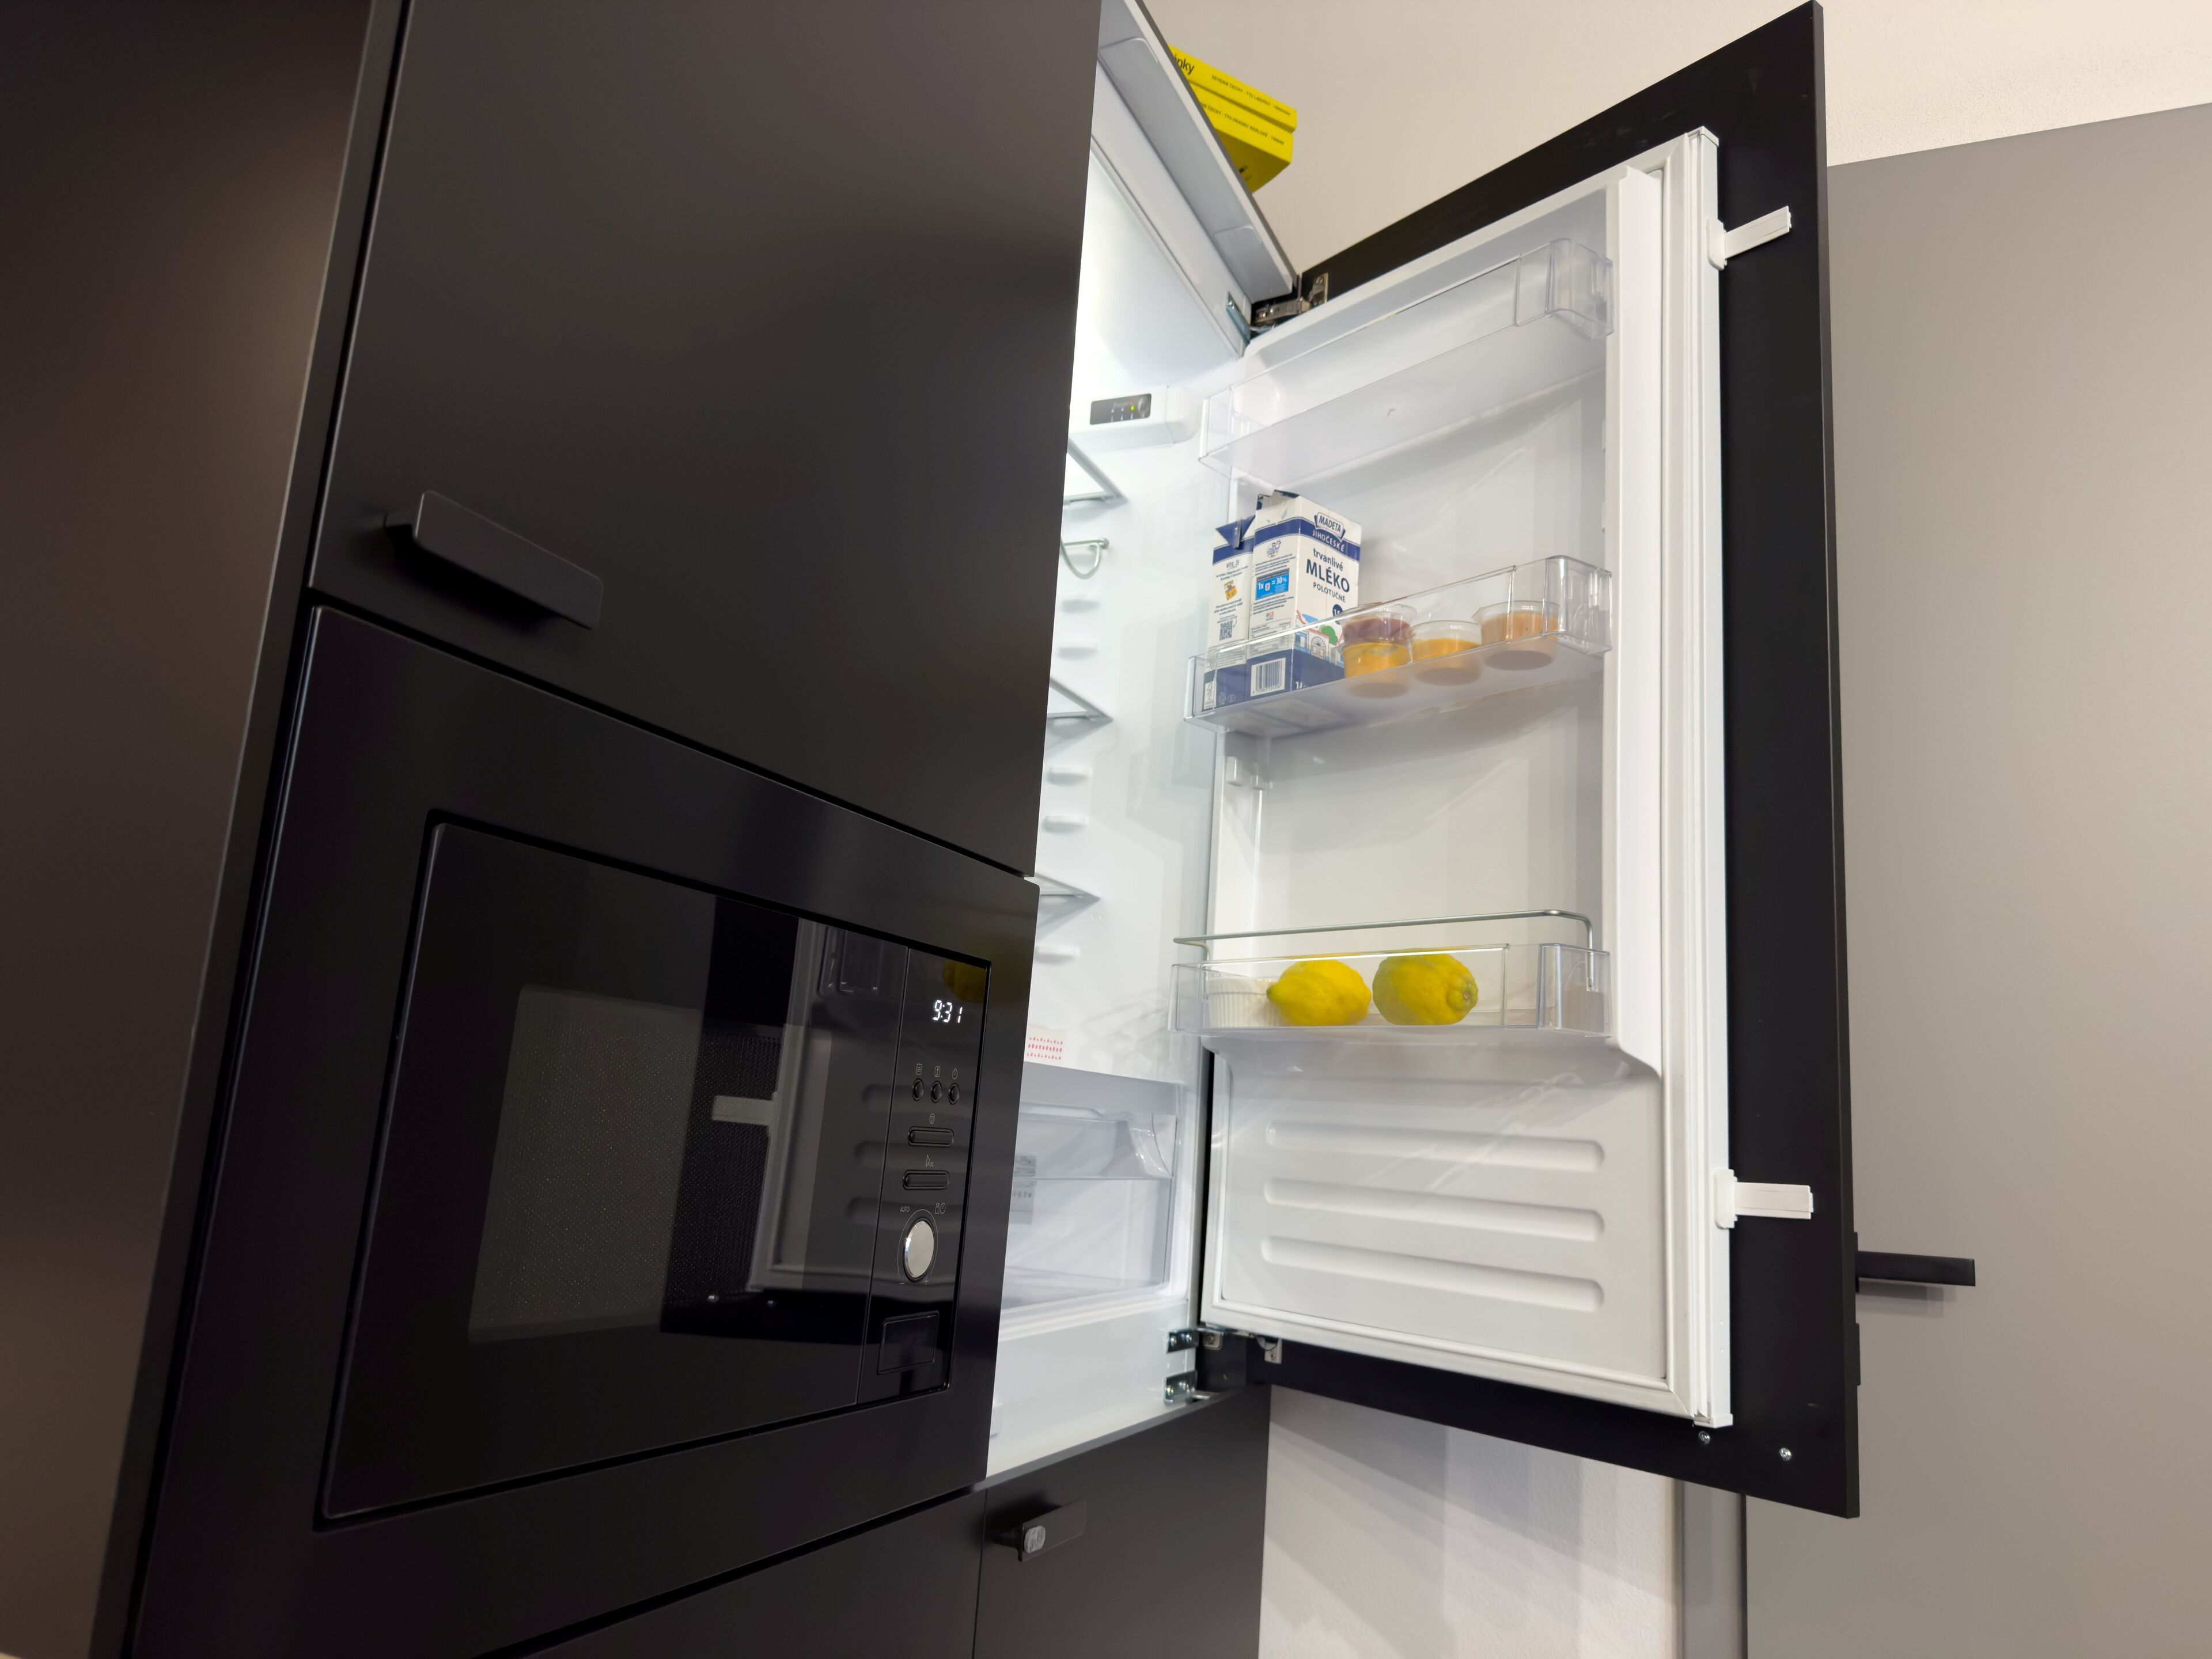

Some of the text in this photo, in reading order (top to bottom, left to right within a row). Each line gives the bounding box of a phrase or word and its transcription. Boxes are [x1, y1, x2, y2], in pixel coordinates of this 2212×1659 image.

[1174, 54, 1195, 75] nky
[1319, 516, 1341, 533] MADETA
[1313, 530, 1345, 552] JIHOČESKÉ
[1313, 548, 1343, 571] trvanlivé
[1306, 558, 1350, 593] MLÉKO
[1313, 582, 1346, 603] POLOTUČNÉ
[931, 999, 963, 1024] 9:31
